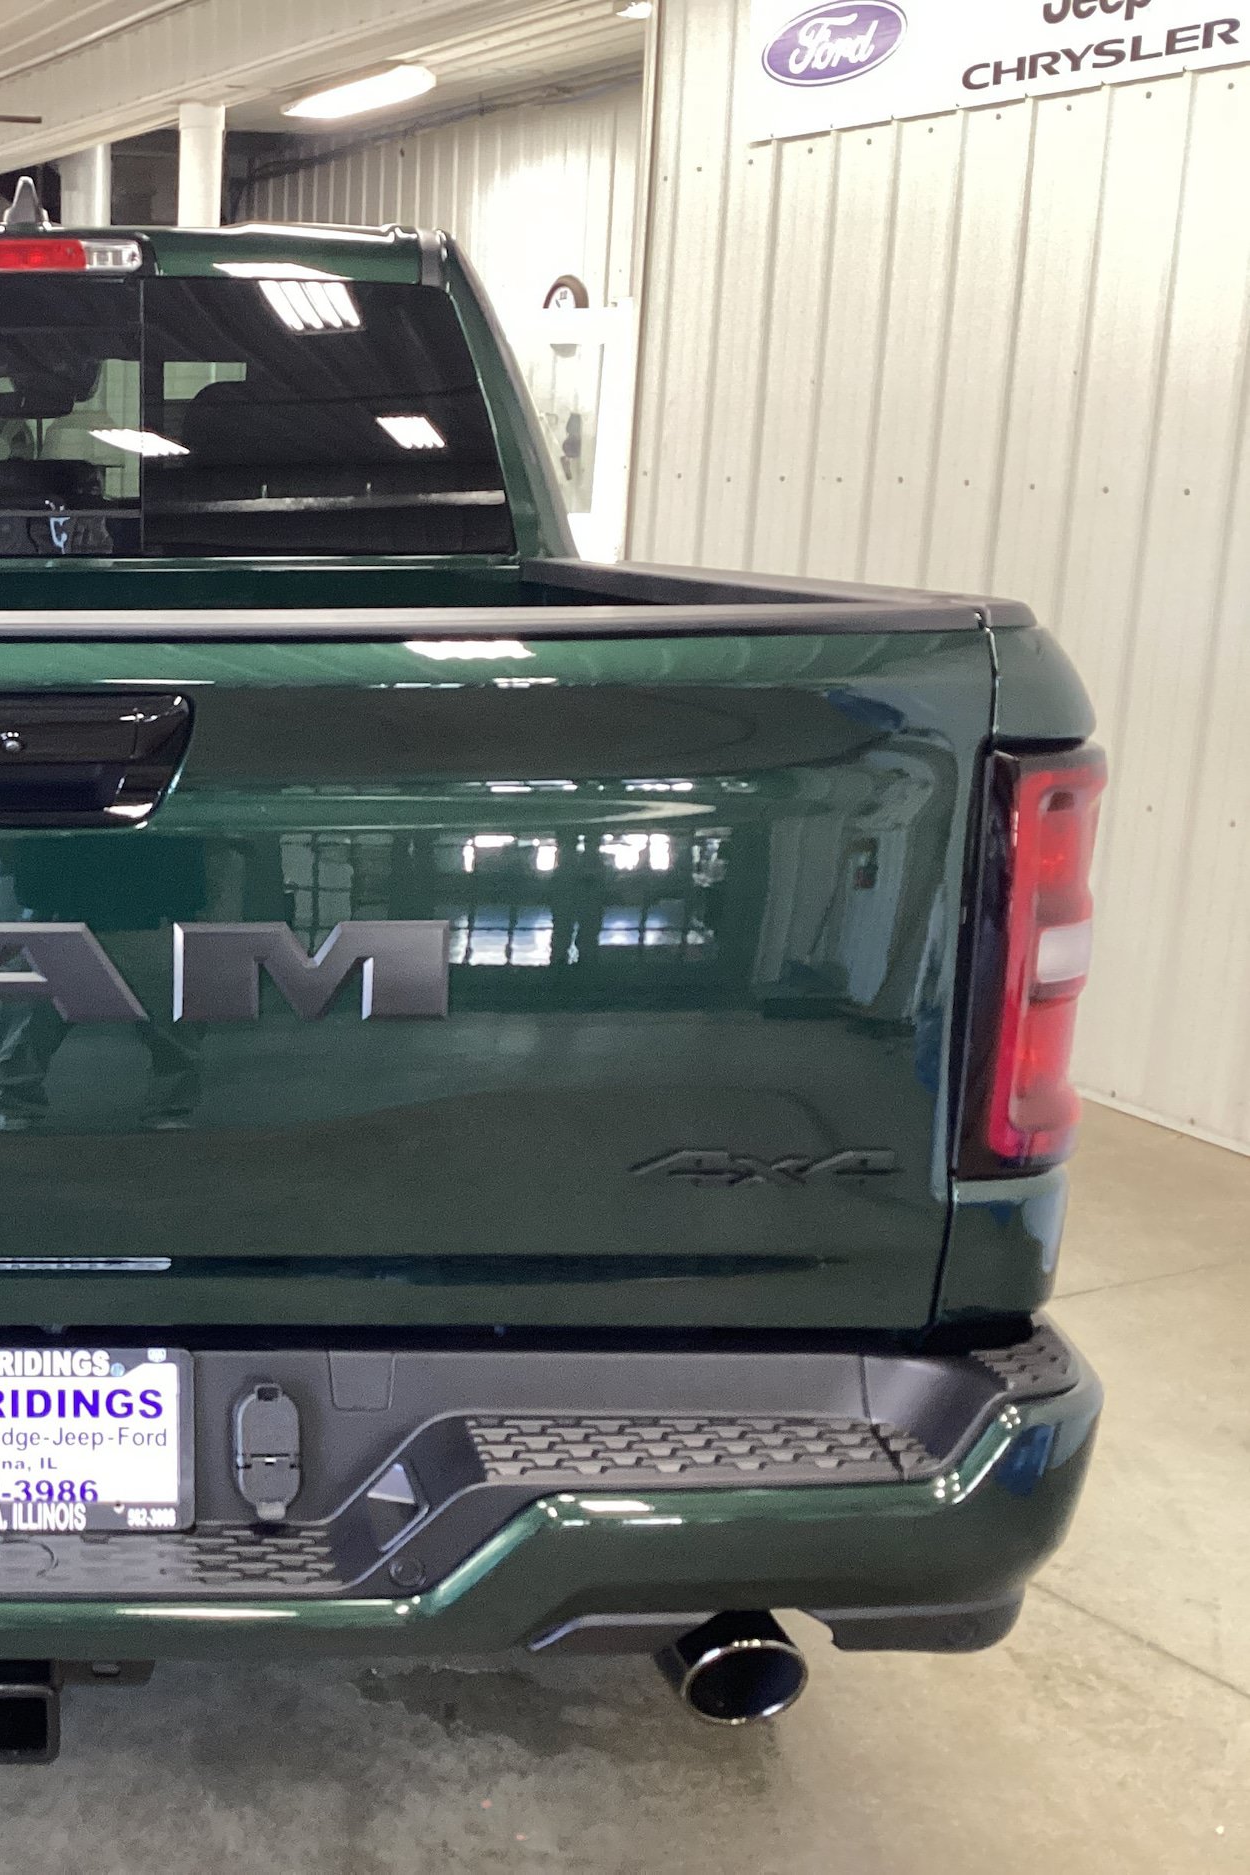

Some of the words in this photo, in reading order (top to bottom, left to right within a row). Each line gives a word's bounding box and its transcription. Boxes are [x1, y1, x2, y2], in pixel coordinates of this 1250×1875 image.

[788, 12, 879, 74] Ford
[961, 17, 1241, 90] CHRYSLER
[40, 1457, 58, 1470] IL
[12, 1502, 87, 1530] ILLINOIS
